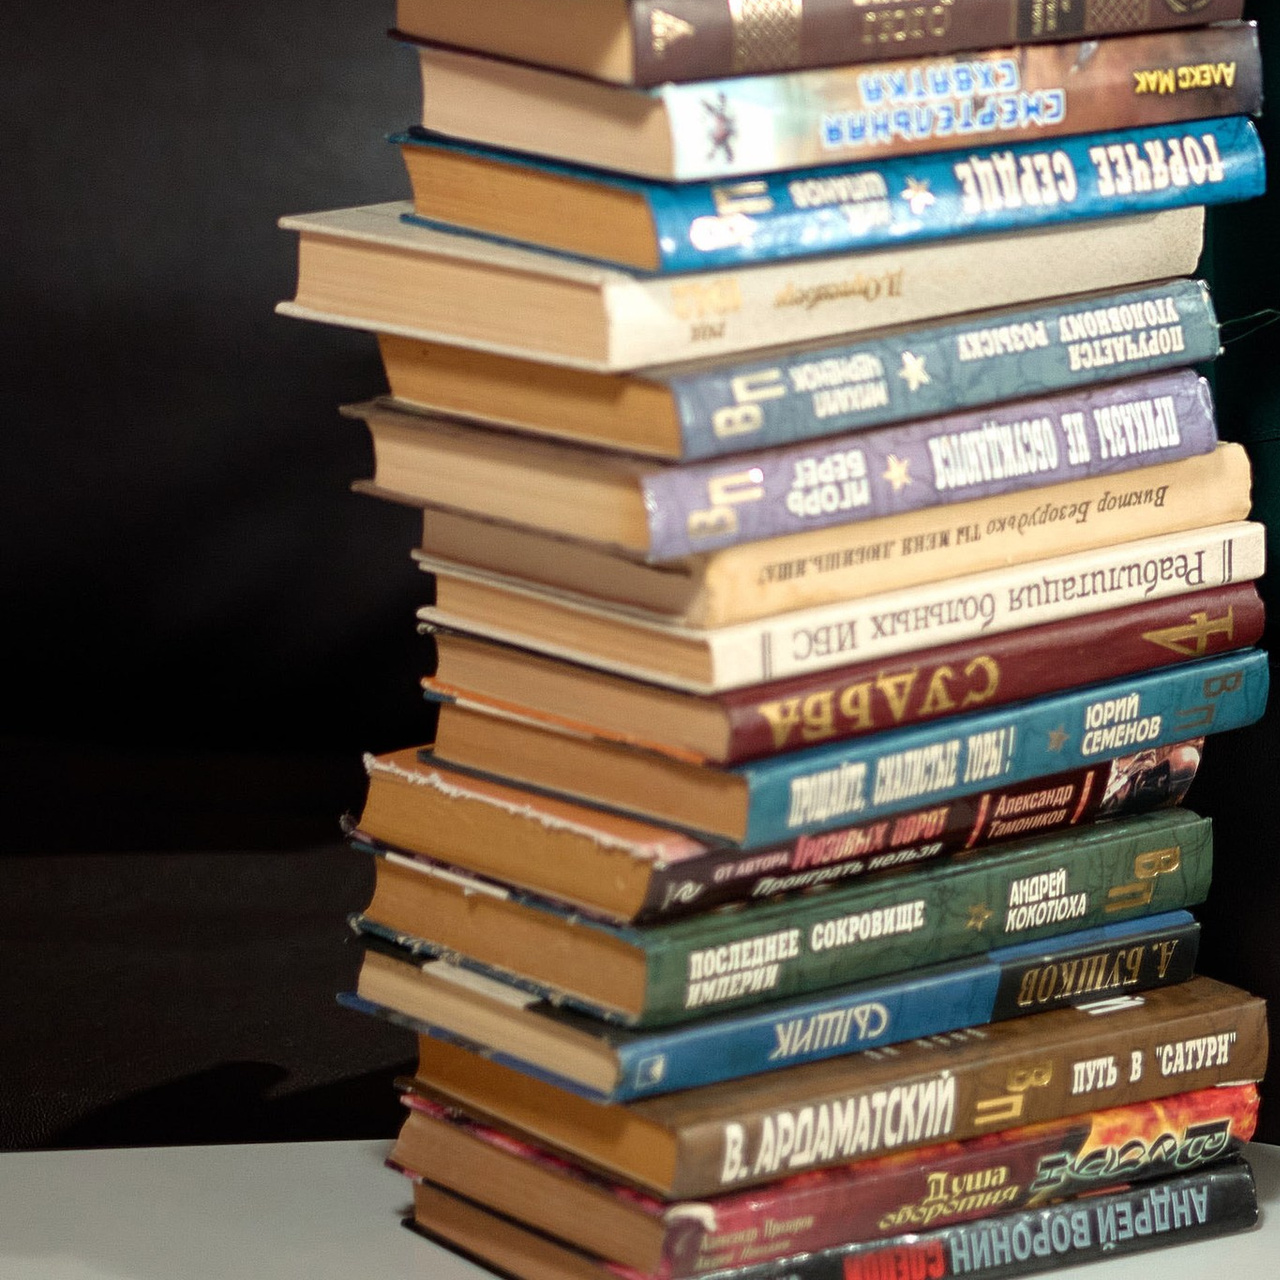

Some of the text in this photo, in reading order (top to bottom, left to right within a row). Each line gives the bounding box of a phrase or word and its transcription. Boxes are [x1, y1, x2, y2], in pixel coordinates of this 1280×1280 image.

[859, 59, 1019, 107] СХВАТКА
[820, 88, 1067, 150] СМЕРТЕЛЬНАЯ
[954, 134, 1224, 216] ГОРЯЧЕЕ СЕРДЦЕ
[956, 295, 1181, 362] УГОЛОВНОМУ РОЗЫСКУ
[1069, 324, 1187, 371] ПОРУЧАЕТСЯ
[929, 397, 1181, 490] ПРИКАЗЫ НЕ ОБСУЖДАЮТСЯ
[792, 449, 868, 490] БЕРЕГ
[785, 477, 872, 517] ИГОРЬ
[986, 499, 1092, 539] Безорудько
[1097, 485, 1169, 513] Виктор
[900, 529, 951, 555] МЕНЯ
[956, 523, 982, 548] ТЫ
[792, 550, 1207, 662] Реабилитация больных ИБС
[757, 655, 1000, 750] СУДЬБА
[1084, 693, 1142, 731] ЮРИЙ
[1082, 715, 1162, 757] СЕМЕНОВ
[993, 783, 1073, 818] Александр
[713, 851, 790, 884] ОТ АВТОРА
[752, 841, 944, 898] Проиграть нельзя
[1008, 868, 1068, 907] АНДРЕЙ
[1004, 892, 1088, 933] КОКОТЮХА
[689, 899, 927, 980] ПОСЛЕДНЕЕ СОКРОВИЩЕ
[1158, 938, 1181, 967] А.
[685, 967, 780, 1011] ИМПЕРИИ
[1016, 946, 1144, 1007] БУШКОВ
[1070, 1031, 1238, 1096] ПУТЬ В "САТУРН"
[718, 1068, 958, 1185] В. АРДАМАТСКИЙ
[925, 1164, 1010, 1208] Душа
[1096, 1183, 1211, 1252] АНДРЕЙ
[949, 1212, 1093, 1278] ВОРОНИН
